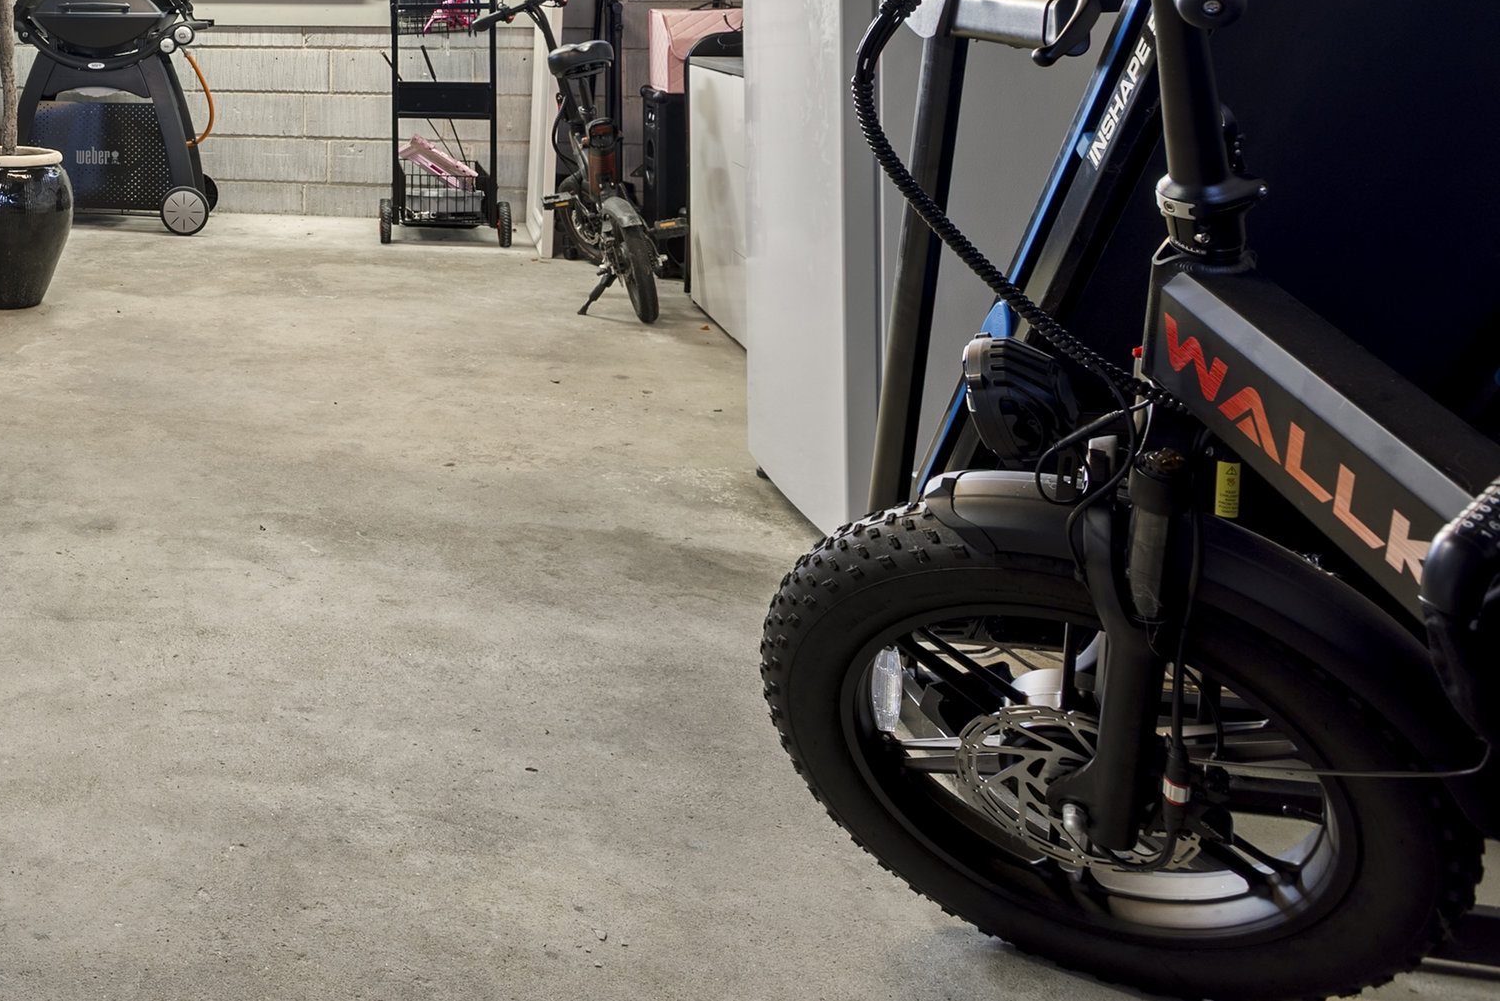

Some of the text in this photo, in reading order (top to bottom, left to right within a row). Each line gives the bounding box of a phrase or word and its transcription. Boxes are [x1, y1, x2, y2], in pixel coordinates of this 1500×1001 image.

[75, 146, 111, 165] weber
[1086, 36, 1152, 171] INSHAPE
[1164, 311, 1433, 587] WALLK
